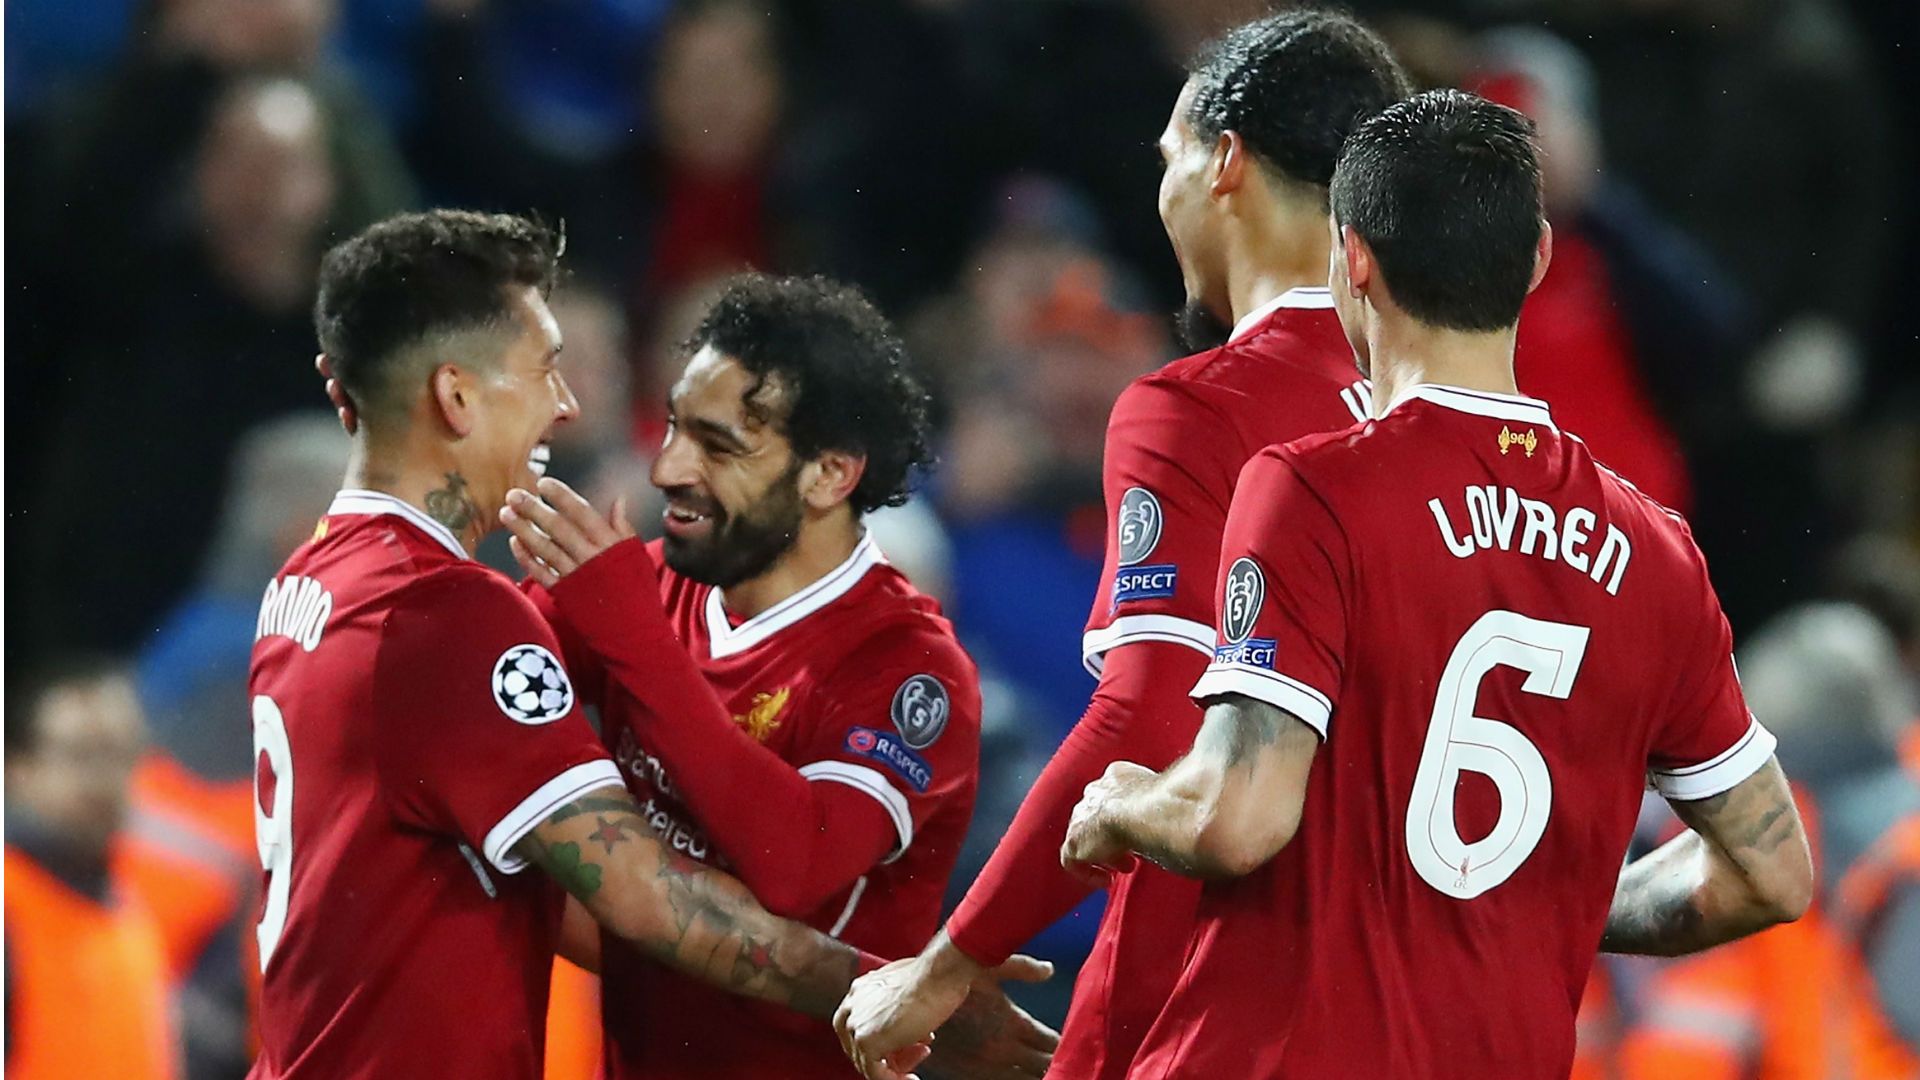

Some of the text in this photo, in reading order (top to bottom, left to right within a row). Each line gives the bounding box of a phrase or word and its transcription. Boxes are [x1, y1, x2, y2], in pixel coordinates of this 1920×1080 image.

[1510, 432, 1526, 445] 96
[1122, 525, 1137, 545] 5
[1427, 485, 1632, 597] LOVREN
[1232, 598, 1243, 621] 5
[876, 738, 931, 789] RESPECT
[1405, 609, 1591, 900] 6
[252, 694, 294, 976] 9
